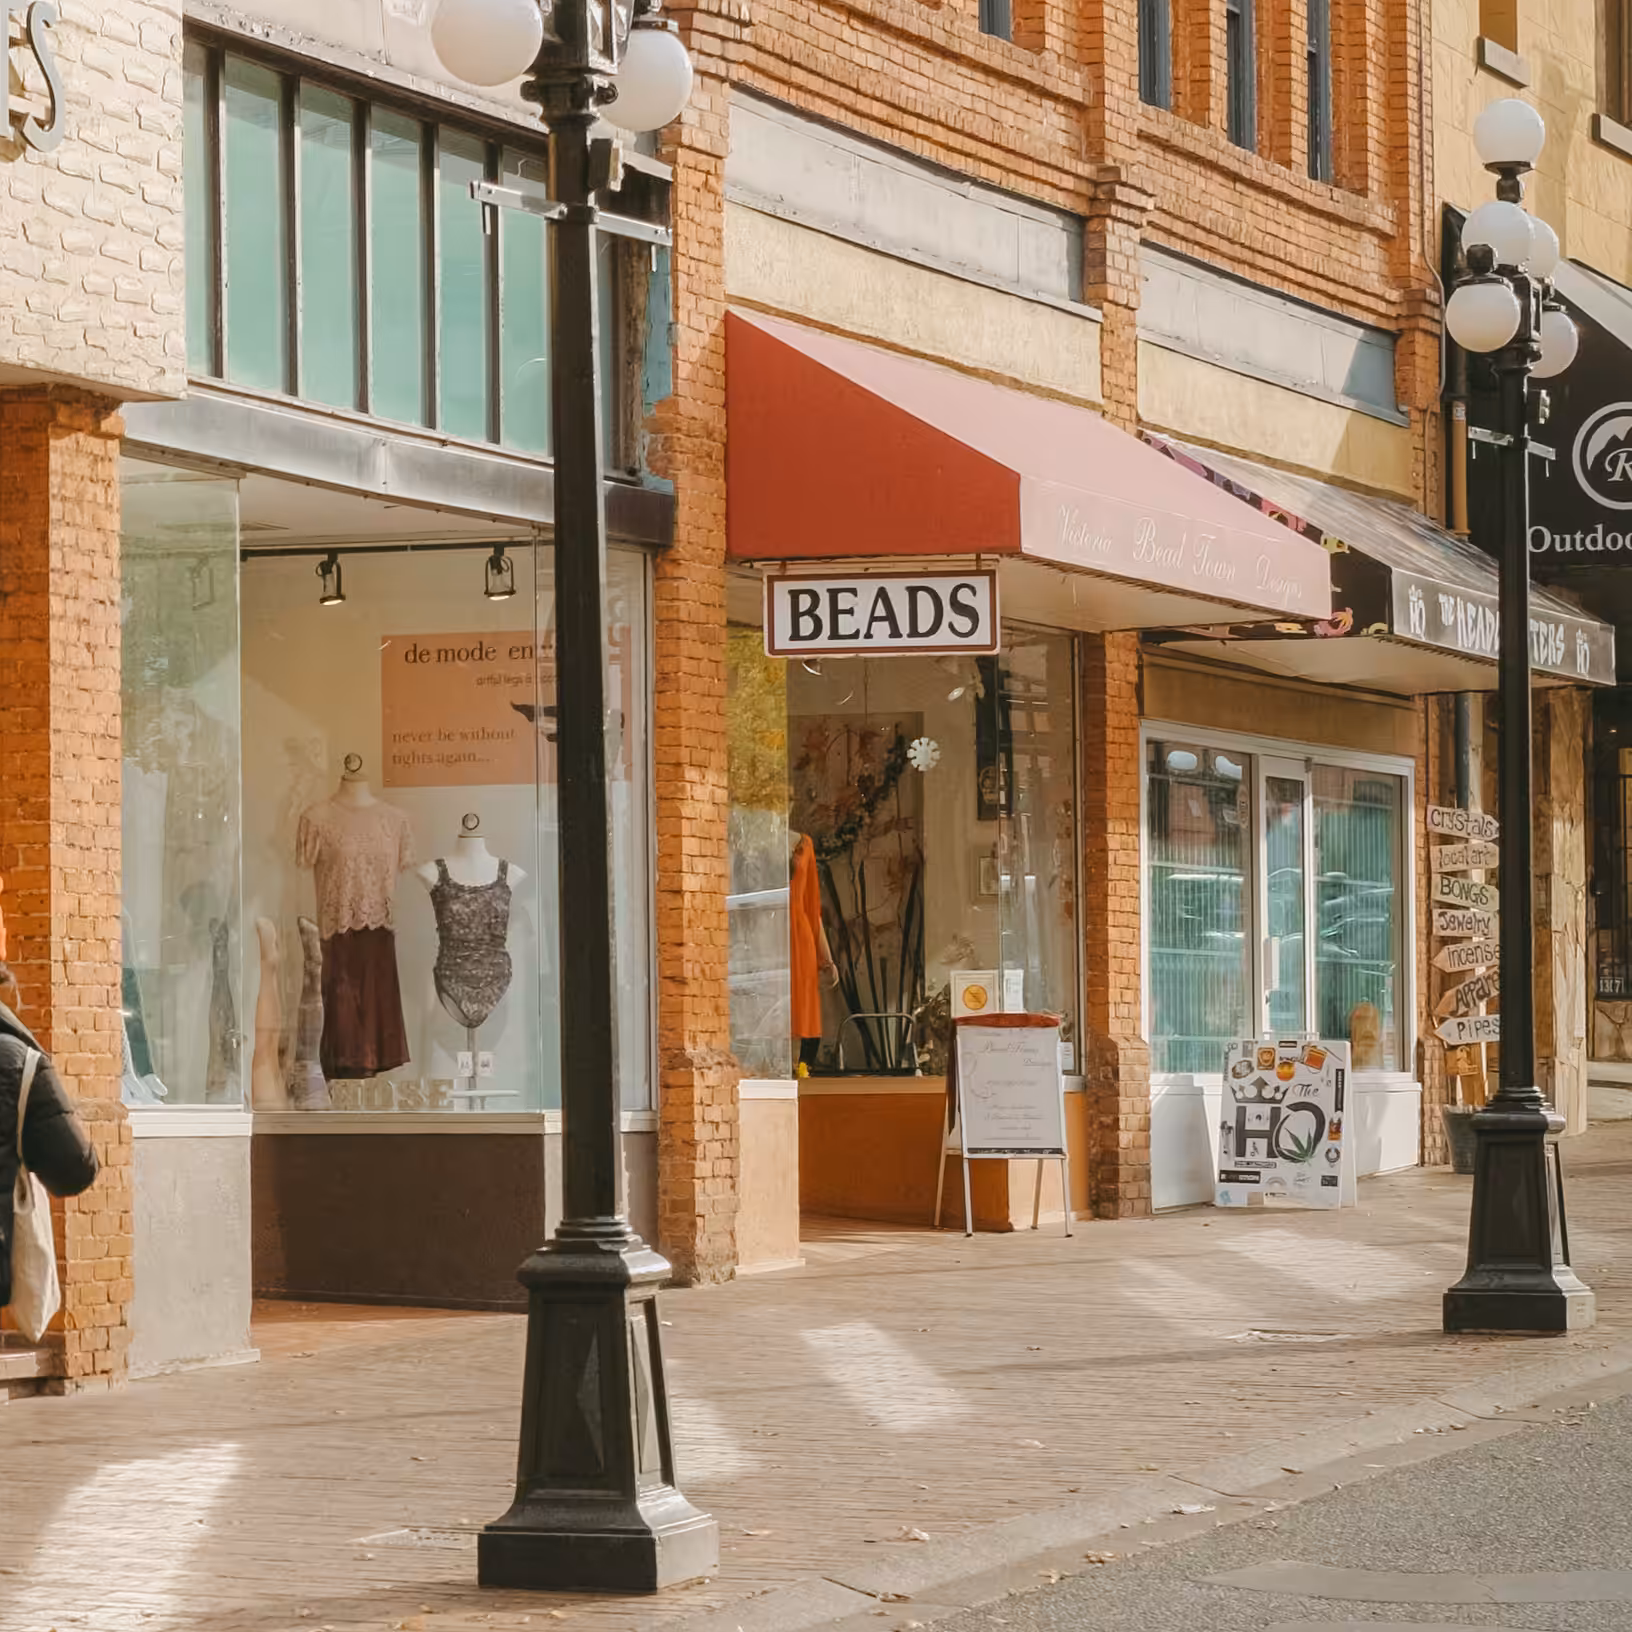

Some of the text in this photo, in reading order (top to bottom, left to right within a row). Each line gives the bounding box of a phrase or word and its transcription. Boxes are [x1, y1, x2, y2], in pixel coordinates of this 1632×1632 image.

[1132, 516, 1187, 568] Bead
[787, 582, 981, 643] BEADS
[404, 643, 430, 664] de
[437, 641, 497, 663] mode
[392, 726, 517, 744] never be without
[1439, 875, 1489, 906] BONGS
